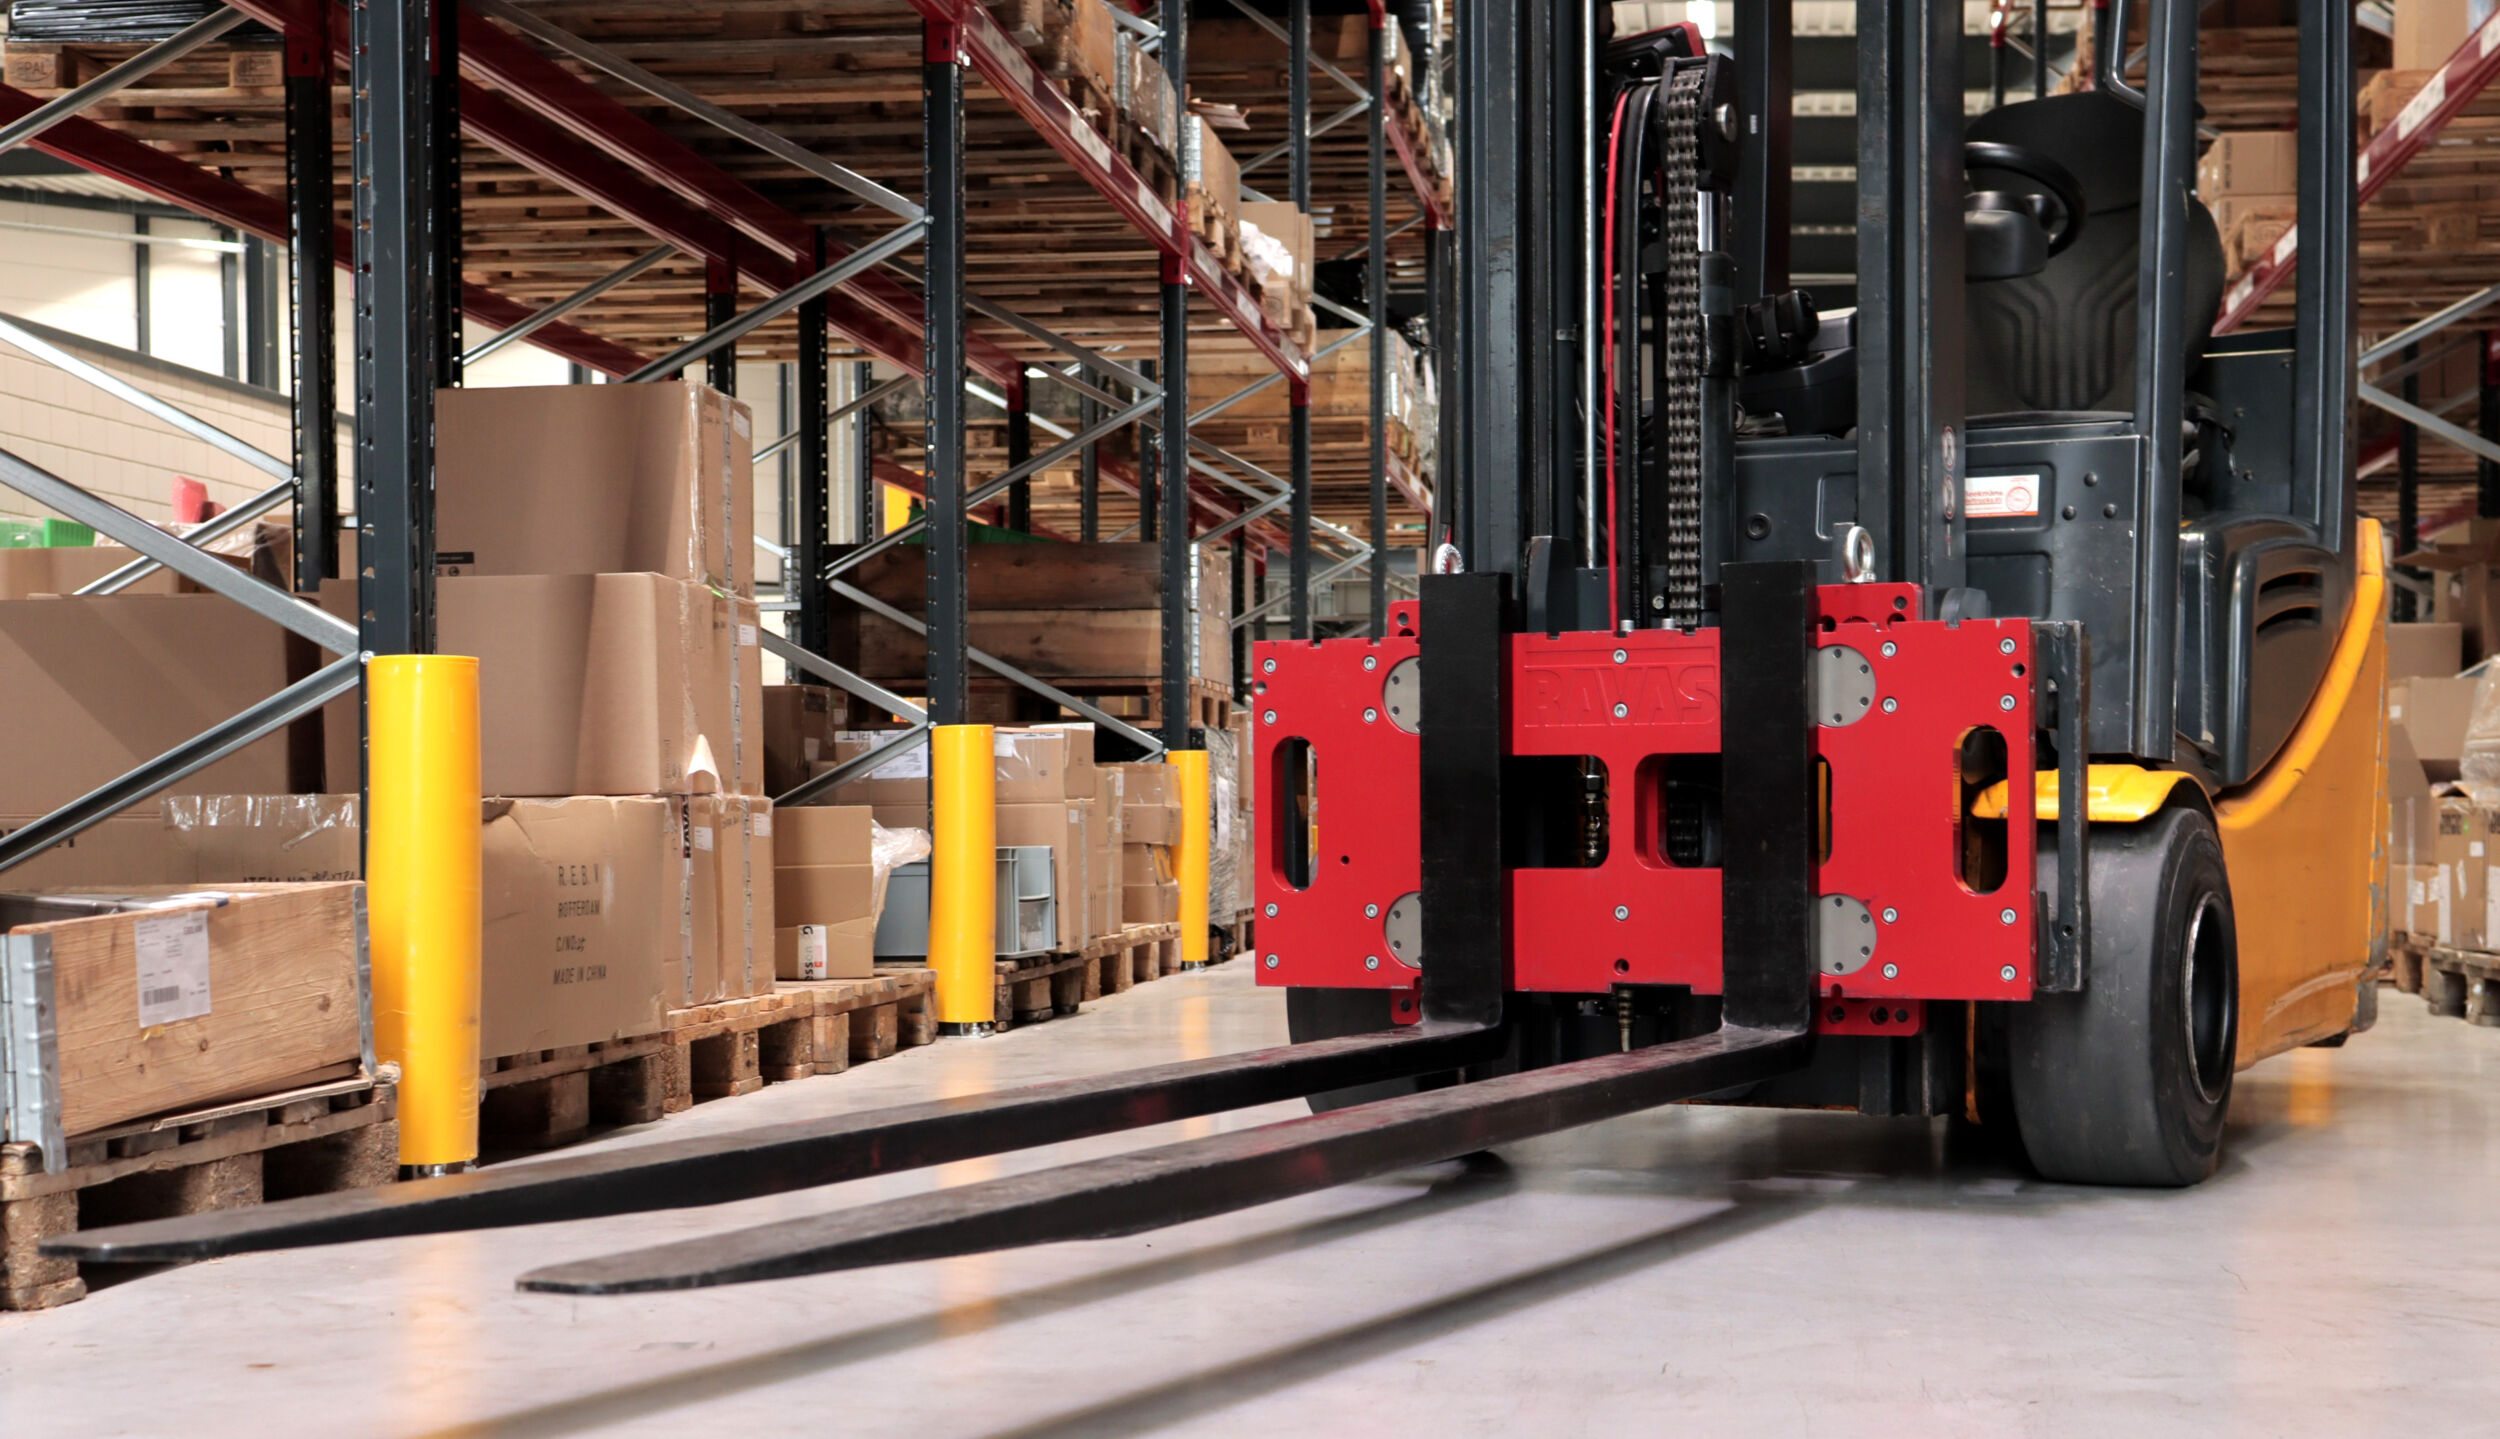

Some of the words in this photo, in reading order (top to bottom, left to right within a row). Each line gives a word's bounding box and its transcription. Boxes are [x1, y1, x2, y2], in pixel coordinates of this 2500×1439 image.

[1525, 664, 1719, 727] RAVAS
[558, 899, 600, 918] ROTTERDAM
[553, 966, 575, 985] MADE
[576, 965, 585, 982] IN
[586, 964, 607, 982] CHINA
